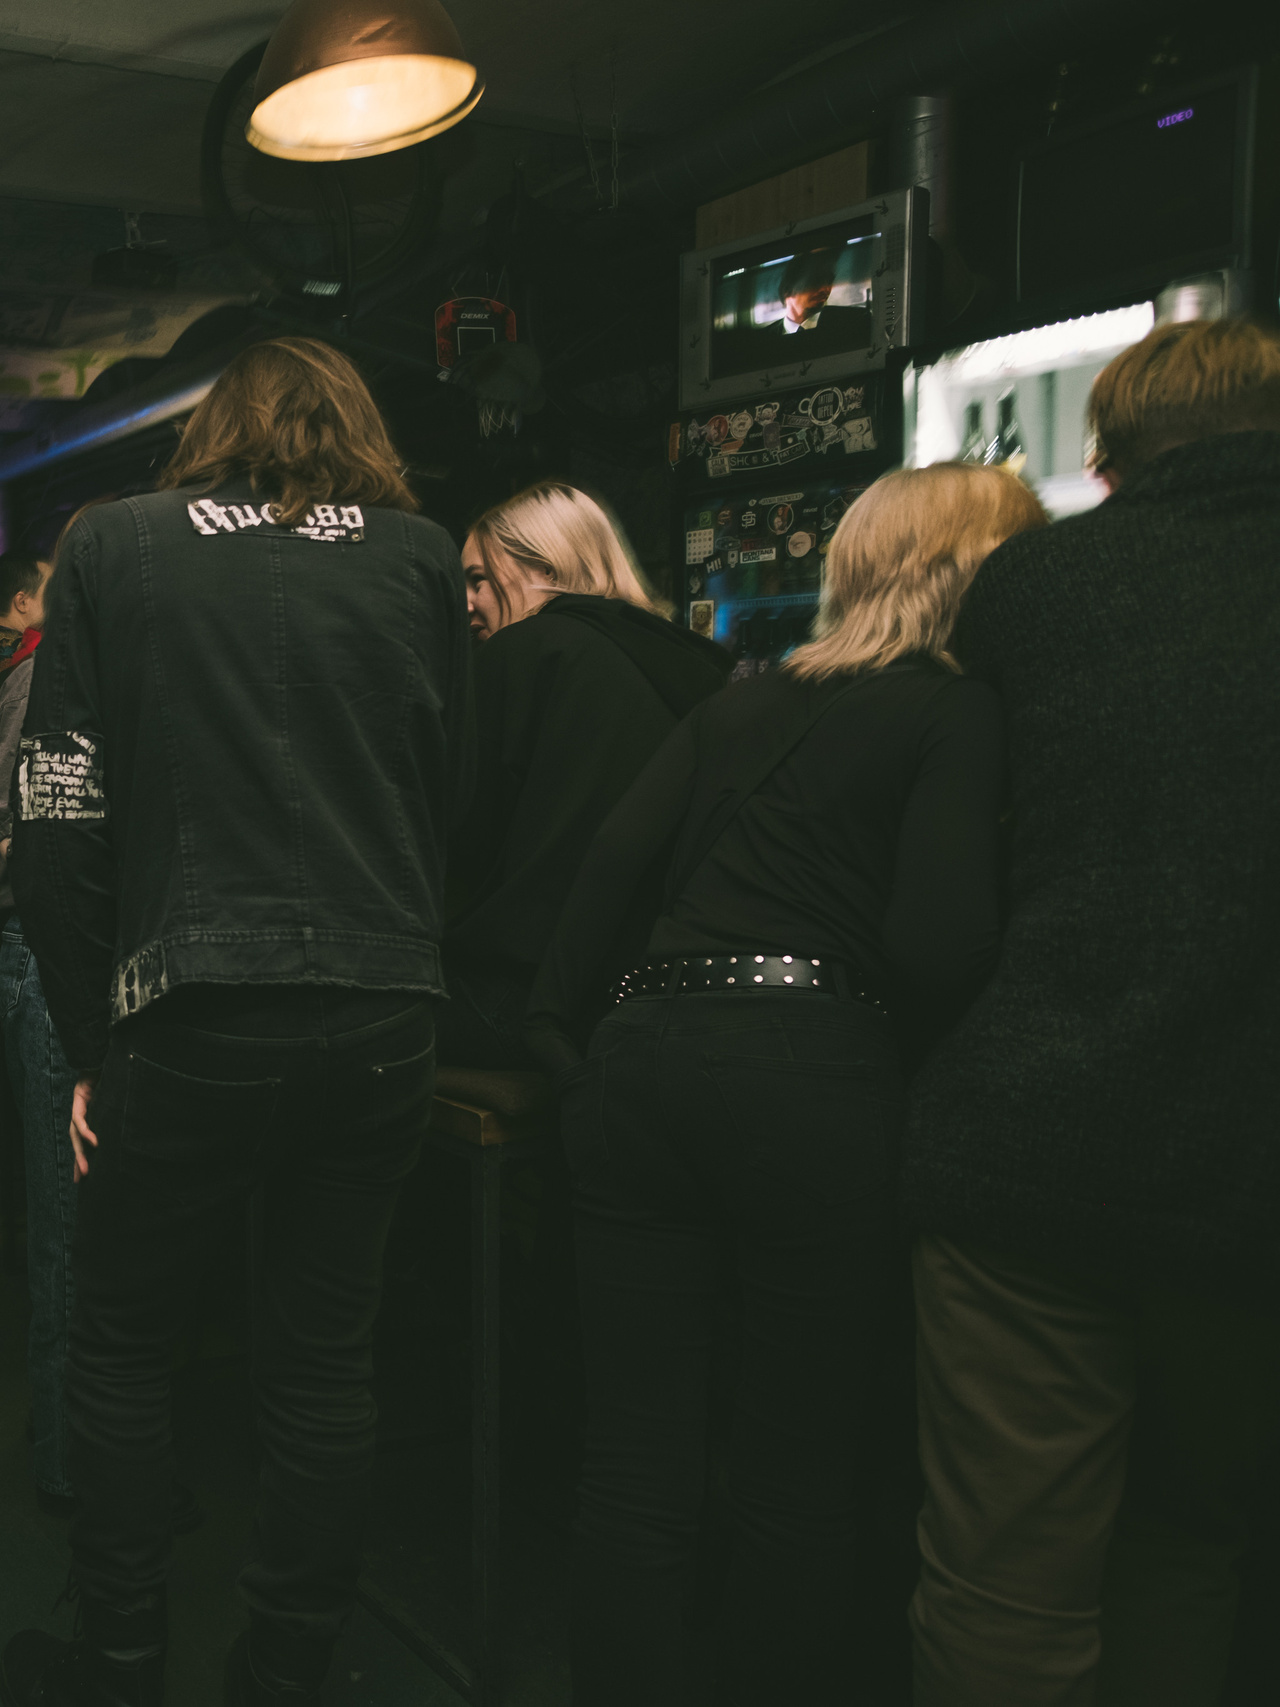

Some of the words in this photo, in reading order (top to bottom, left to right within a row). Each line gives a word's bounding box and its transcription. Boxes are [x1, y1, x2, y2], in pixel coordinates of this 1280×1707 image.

[1157, 108, 1193, 129] VIDEO
[742, 548, 774, 558] MONTANA
[742, 555, 761, 563] CANS
[706, 557, 722, 573] HI!
[56, 797, 84, 809] EVIL
